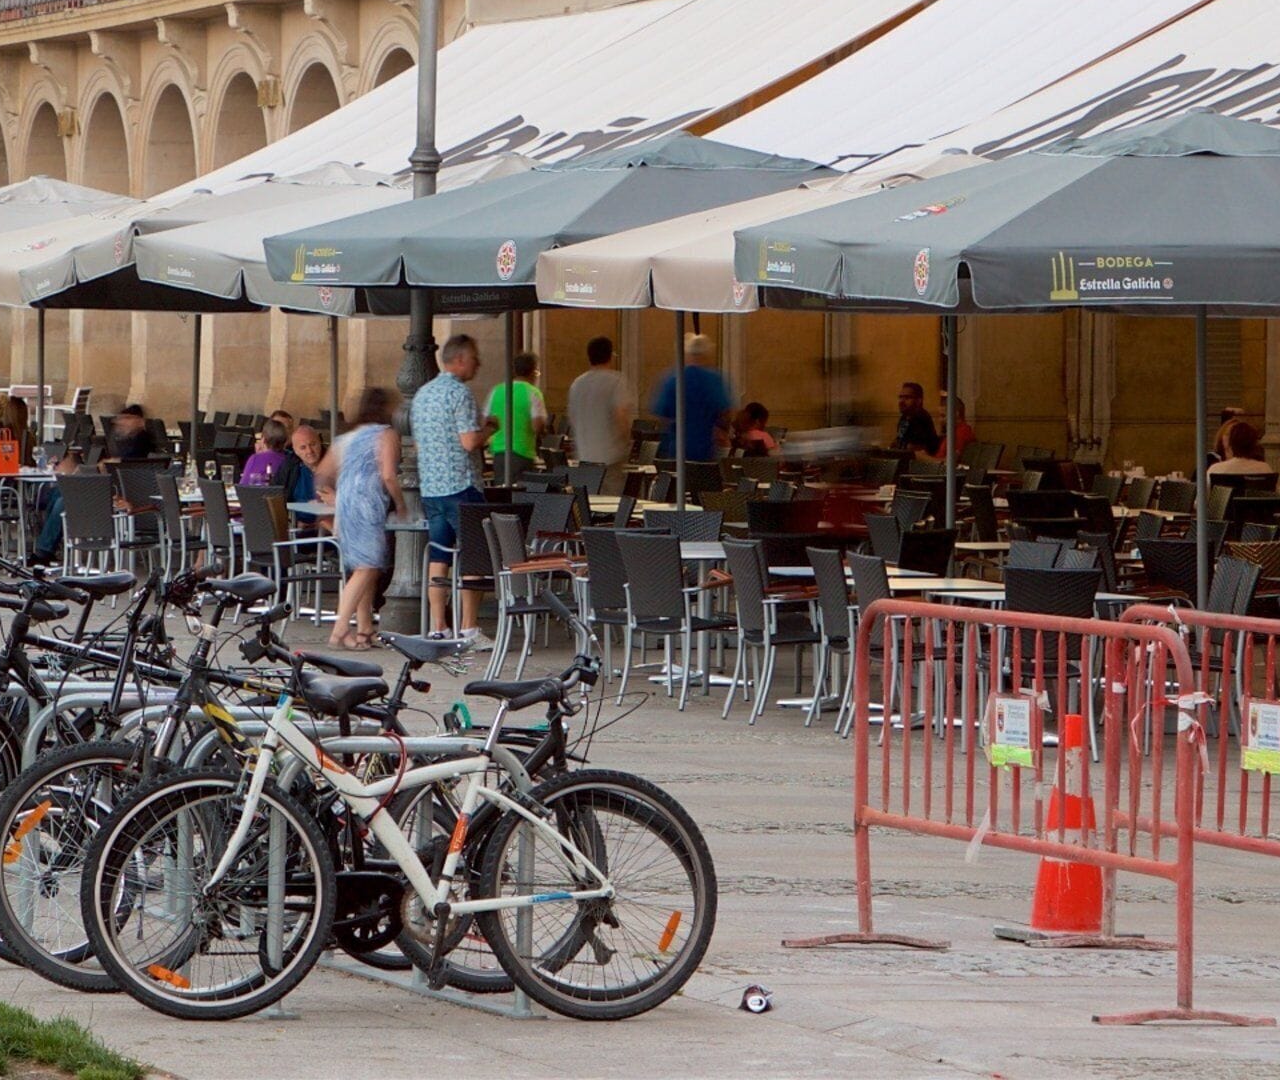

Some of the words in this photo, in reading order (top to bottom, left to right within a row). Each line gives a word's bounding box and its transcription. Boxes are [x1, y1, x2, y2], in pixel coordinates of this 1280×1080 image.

[1096, 257, 1154, 268] BODEGA
[1080, 278, 1121, 290] Estrella
[1122, 277, 1160, 290] Galicia
